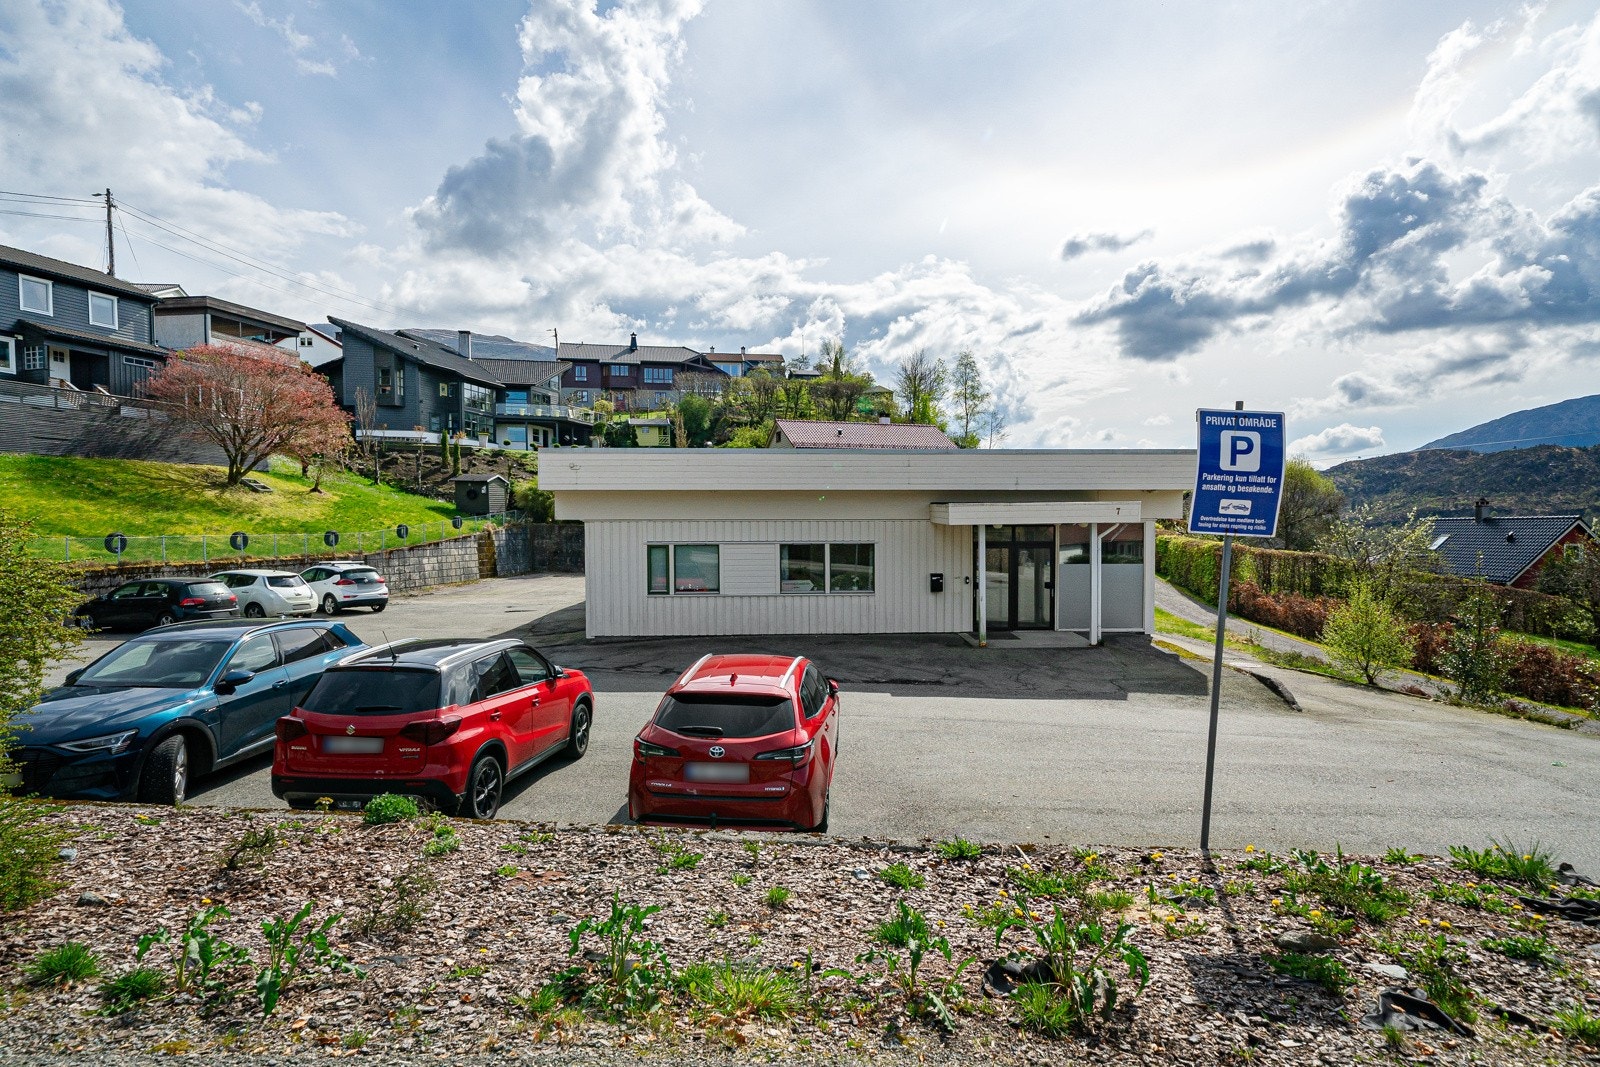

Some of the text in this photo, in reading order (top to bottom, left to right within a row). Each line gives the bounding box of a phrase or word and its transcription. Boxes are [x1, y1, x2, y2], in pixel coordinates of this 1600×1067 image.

[1205, 416, 1277, 428] PRIVAT OMRÅDE
[1230, 435, 1254, 466] P
[1202, 473, 1277, 484] Parkering kun tillatt for
[1227, 485, 1236, 493] og
[1237, 485, 1274, 494] besøkende.
